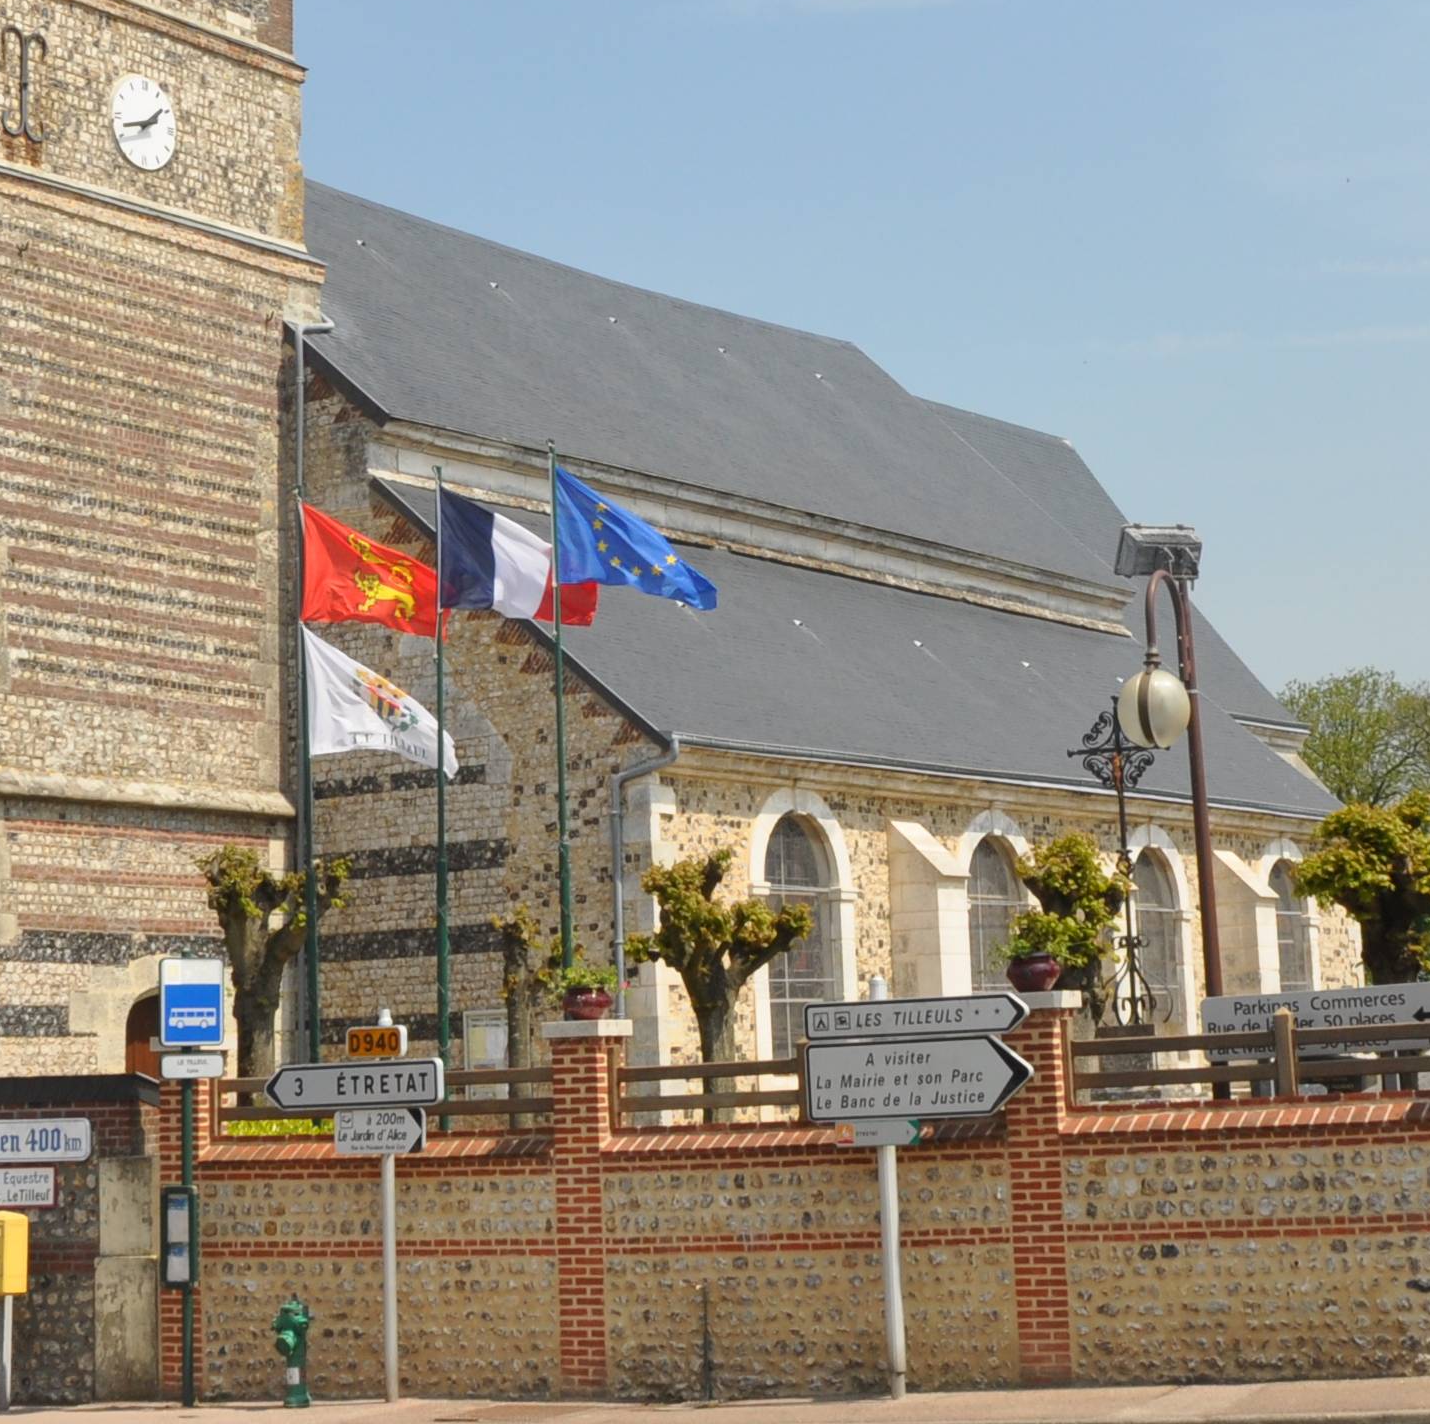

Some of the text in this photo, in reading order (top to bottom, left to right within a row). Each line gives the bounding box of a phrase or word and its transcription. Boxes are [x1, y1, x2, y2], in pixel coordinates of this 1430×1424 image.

[1310, 993, 1406, 1011] Commerces
[856, 1008, 964, 1027] LES TILLEULS
[1207, 1022, 1236, 1033] Rue
[1241, 1019, 1261, 1032] de
[1323, 1014, 1343, 1026] 50
[1349, 1011, 1396, 1026] places
[349, 1031, 399, 1053] D940
[865, 1051, 931, 1066] A visiter
[294, 1071, 428, 1097] 3 ÉTRETAT
[816, 1069, 984, 1090] La Mairie et son Parc
[816, 1090, 985, 1110] Le Banc de la Justice
[376, 1113, 405, 1125] 200m
[25, 1128, 61, 1152] 400
[338, 1129, 348, 1142] Le
[351, 1129, 375, 1141] Jardin
